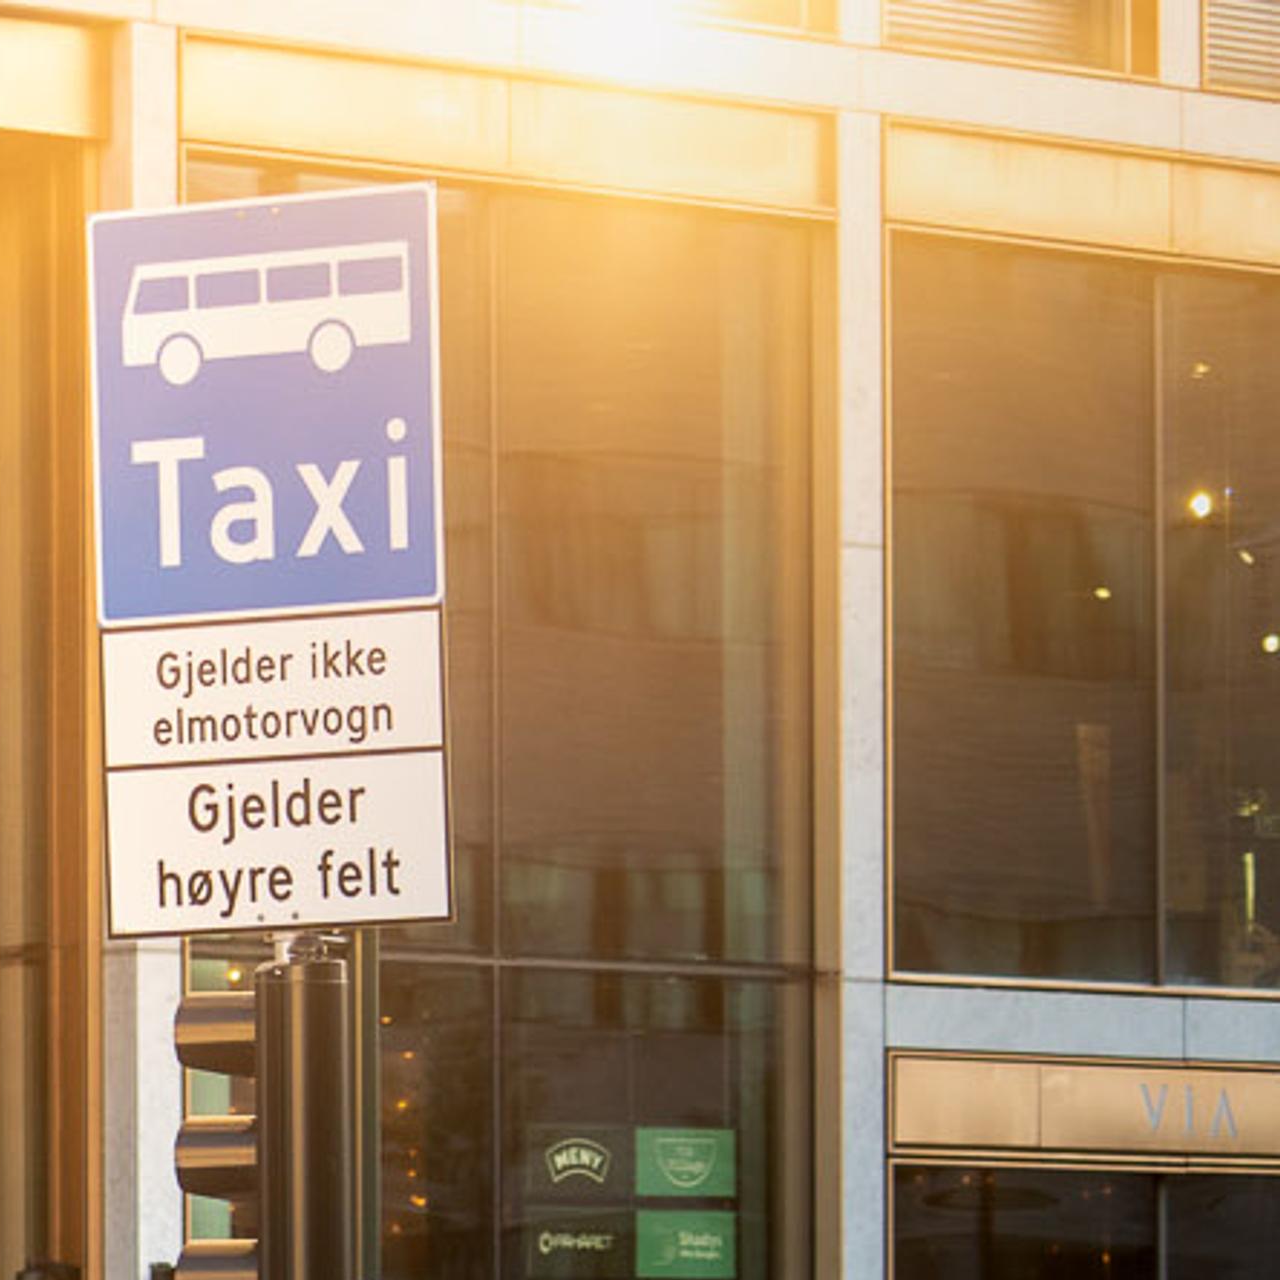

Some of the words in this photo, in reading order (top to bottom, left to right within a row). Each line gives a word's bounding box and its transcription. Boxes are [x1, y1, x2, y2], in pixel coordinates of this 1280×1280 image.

[130, 416, 410, 569] Taxi
[156, 646, 294, 698] Gjelder
[309, 640, 388, 680] ikke
[152, 698, 394, 748] elmotorvogn
[187, 778, 366, 845] Gjelder
[157, 858, 295, 918] høyre
[317, 848, 401, 900] felt
[1138, 1082, 1239, 1138] VIA
